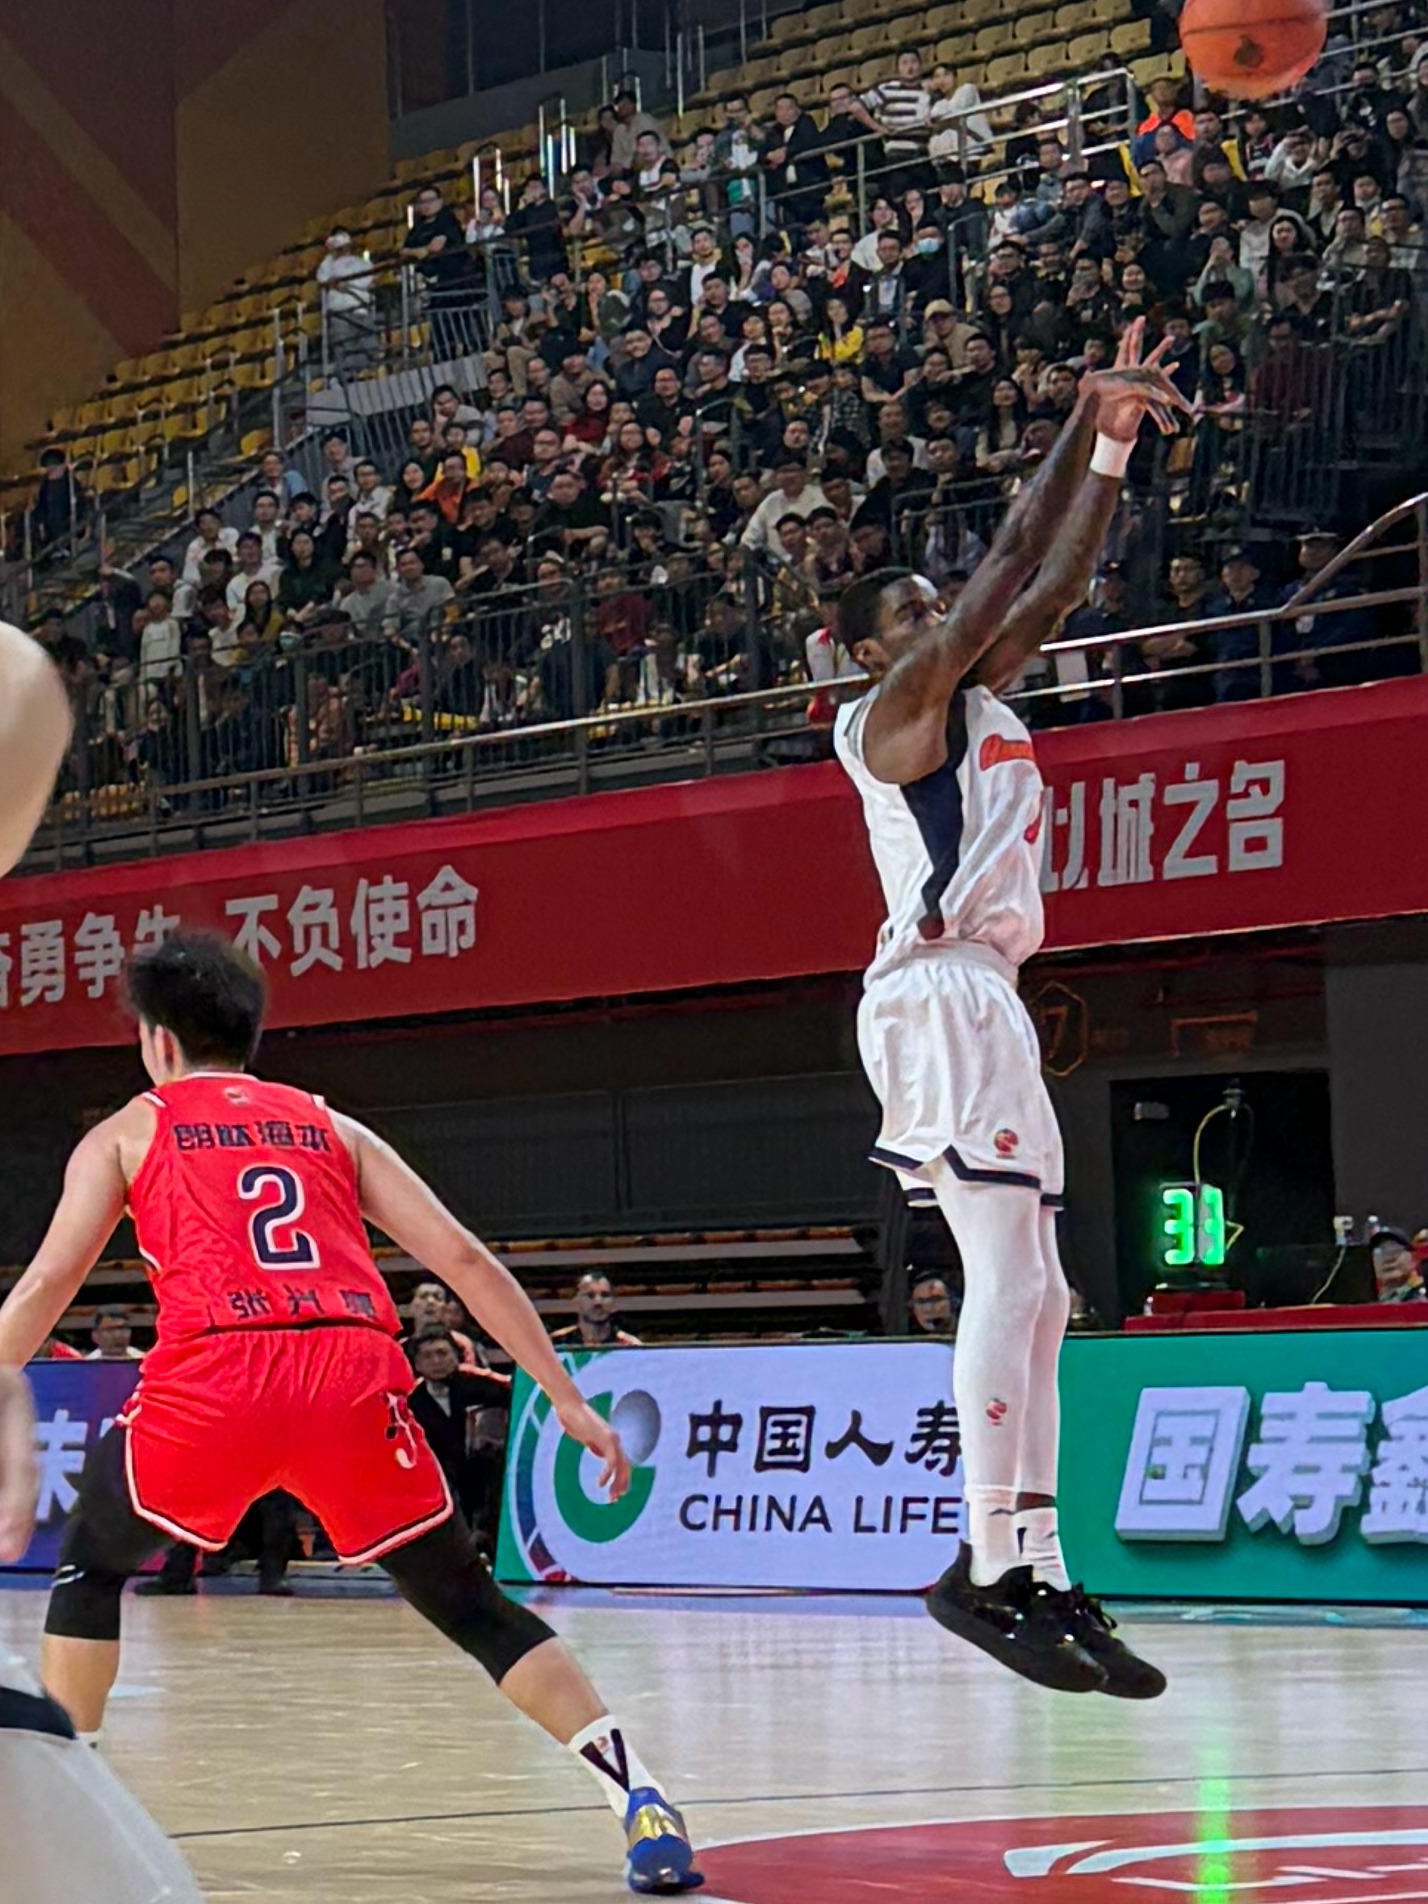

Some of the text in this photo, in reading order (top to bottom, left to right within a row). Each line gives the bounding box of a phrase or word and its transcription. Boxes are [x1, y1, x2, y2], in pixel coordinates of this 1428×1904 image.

[225, 864, 480, 978] 不负使命
[236, 1162, 321, 1271] 2
[686, 1399, 962, 1478] 中国人寿
[679, 1494, 963, 1534] CHINA LIFE
